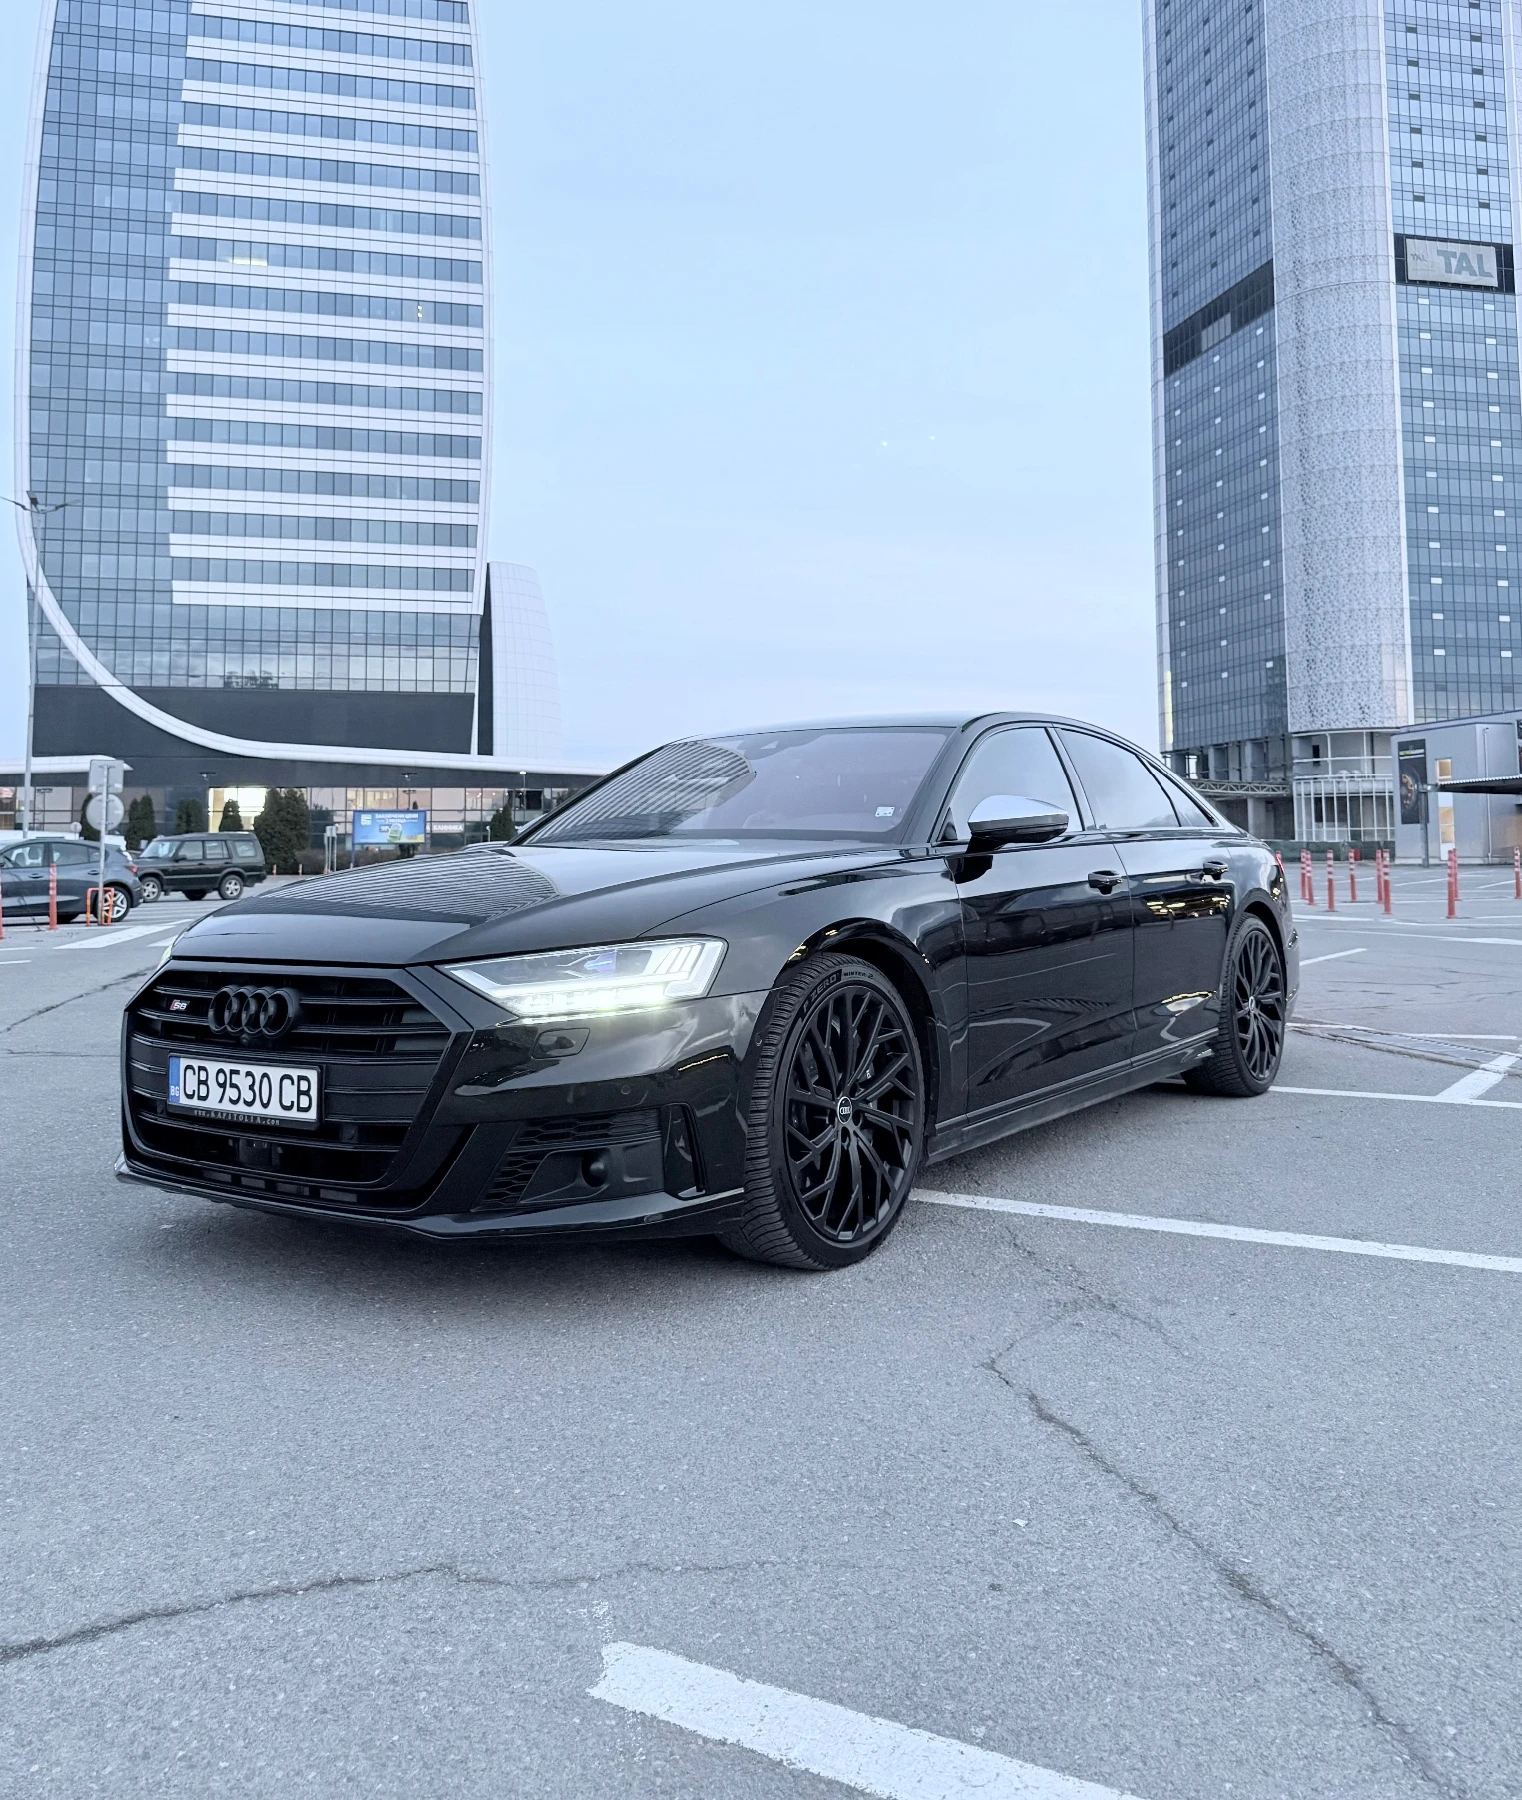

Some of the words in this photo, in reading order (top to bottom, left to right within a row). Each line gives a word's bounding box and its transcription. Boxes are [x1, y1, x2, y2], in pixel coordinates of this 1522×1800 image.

[1436, 249, 1495, 278] TAL
[810, 974, 837, 1001] ZERO
[170, 1085, 180, 1097] BG
[183, 1064, 210, 1101] CB
[215, 1067, 273, 1109] 9530
[279, 1073, 313, 1113] CB
